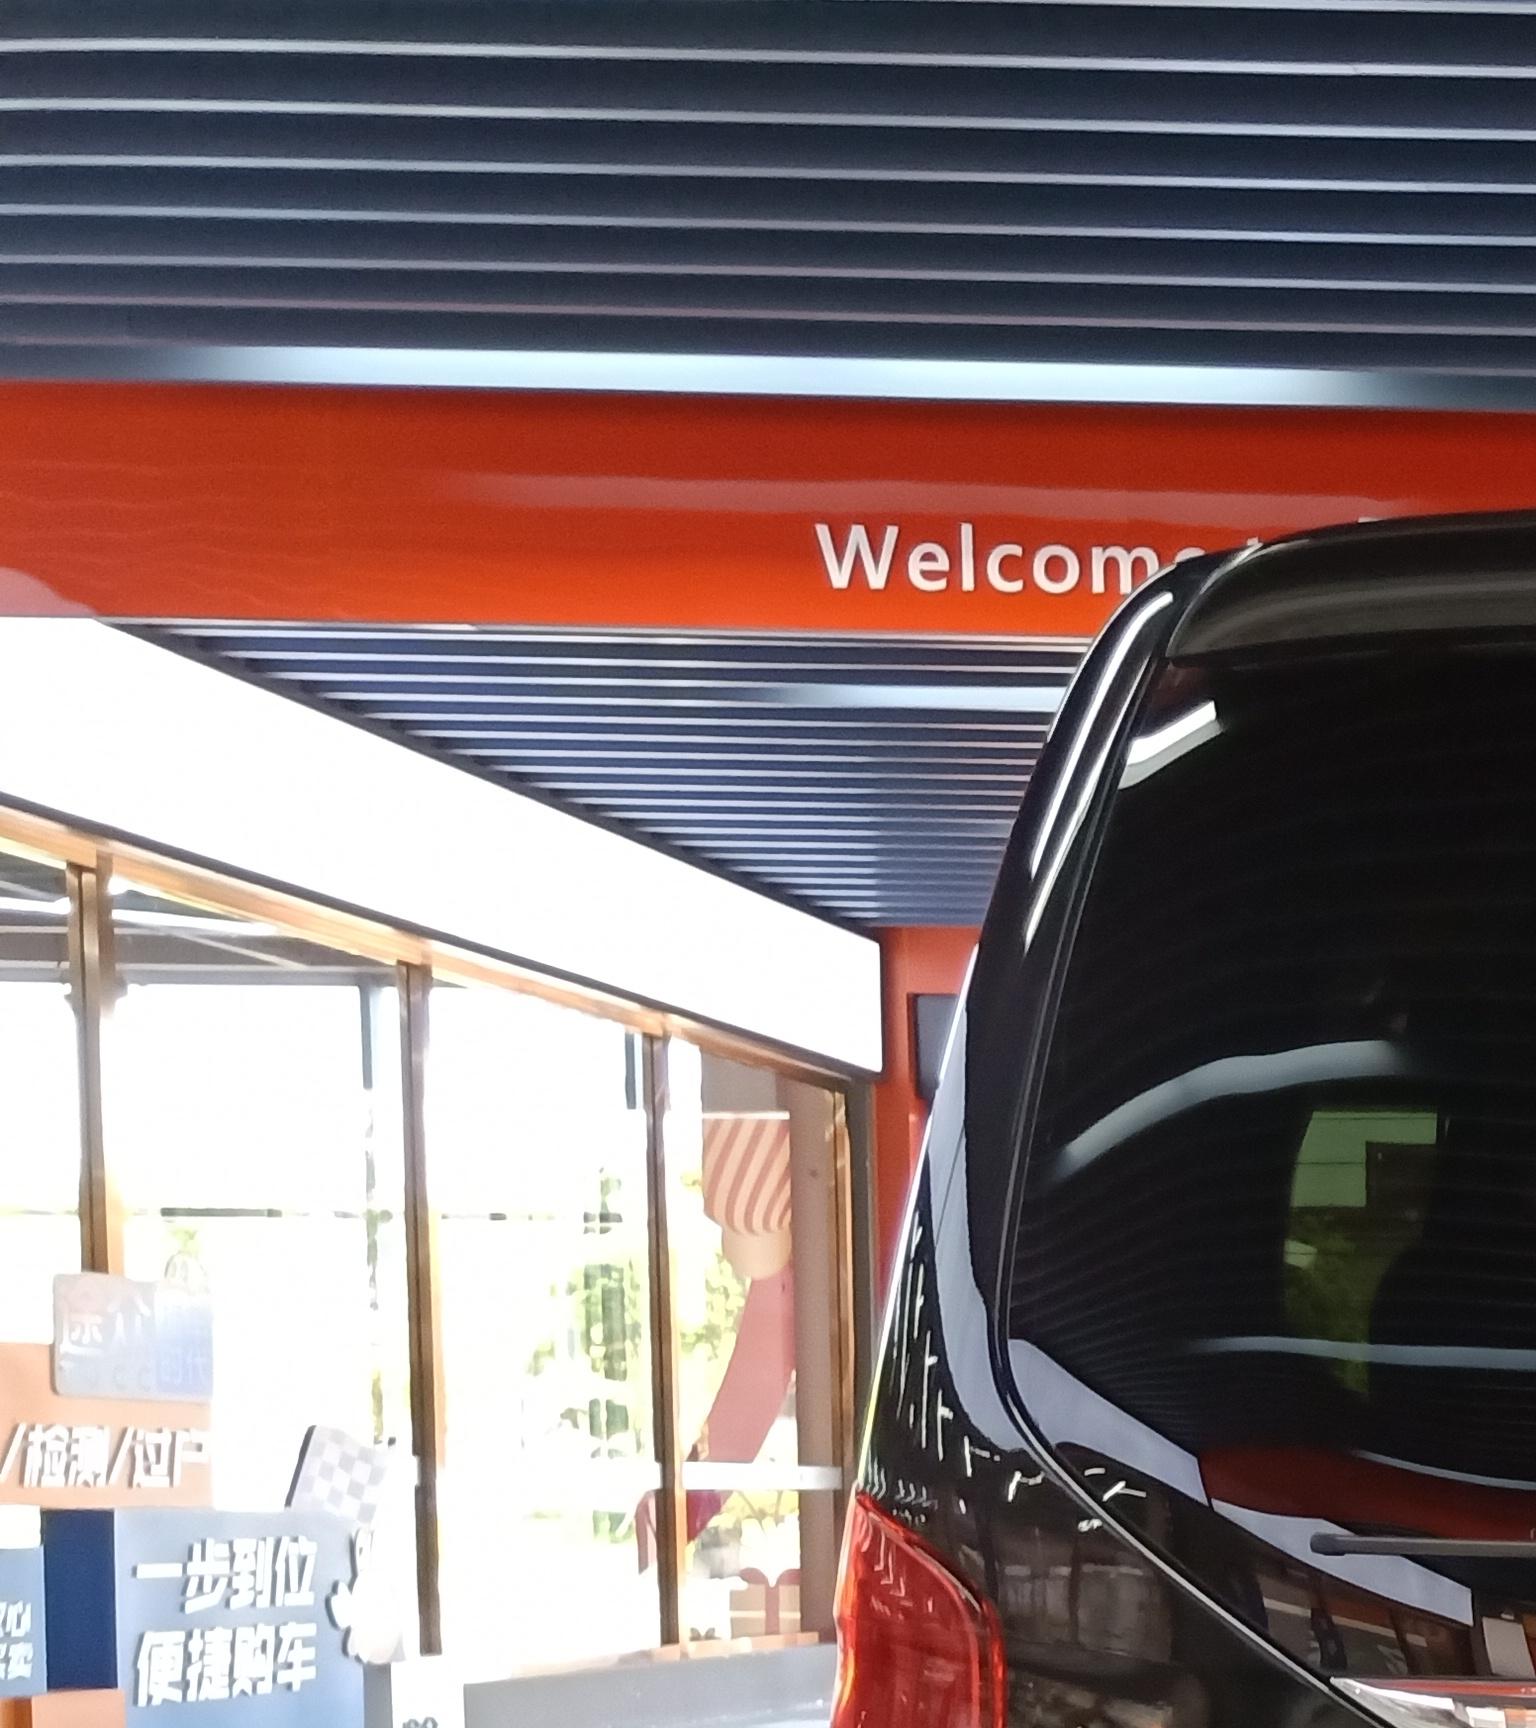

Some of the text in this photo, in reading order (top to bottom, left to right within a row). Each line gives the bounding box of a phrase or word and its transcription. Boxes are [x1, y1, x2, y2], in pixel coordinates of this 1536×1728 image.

[134, 1535, 318, 1615] 一步到位
[135, 1621, 318, 1707] 便捷购车
